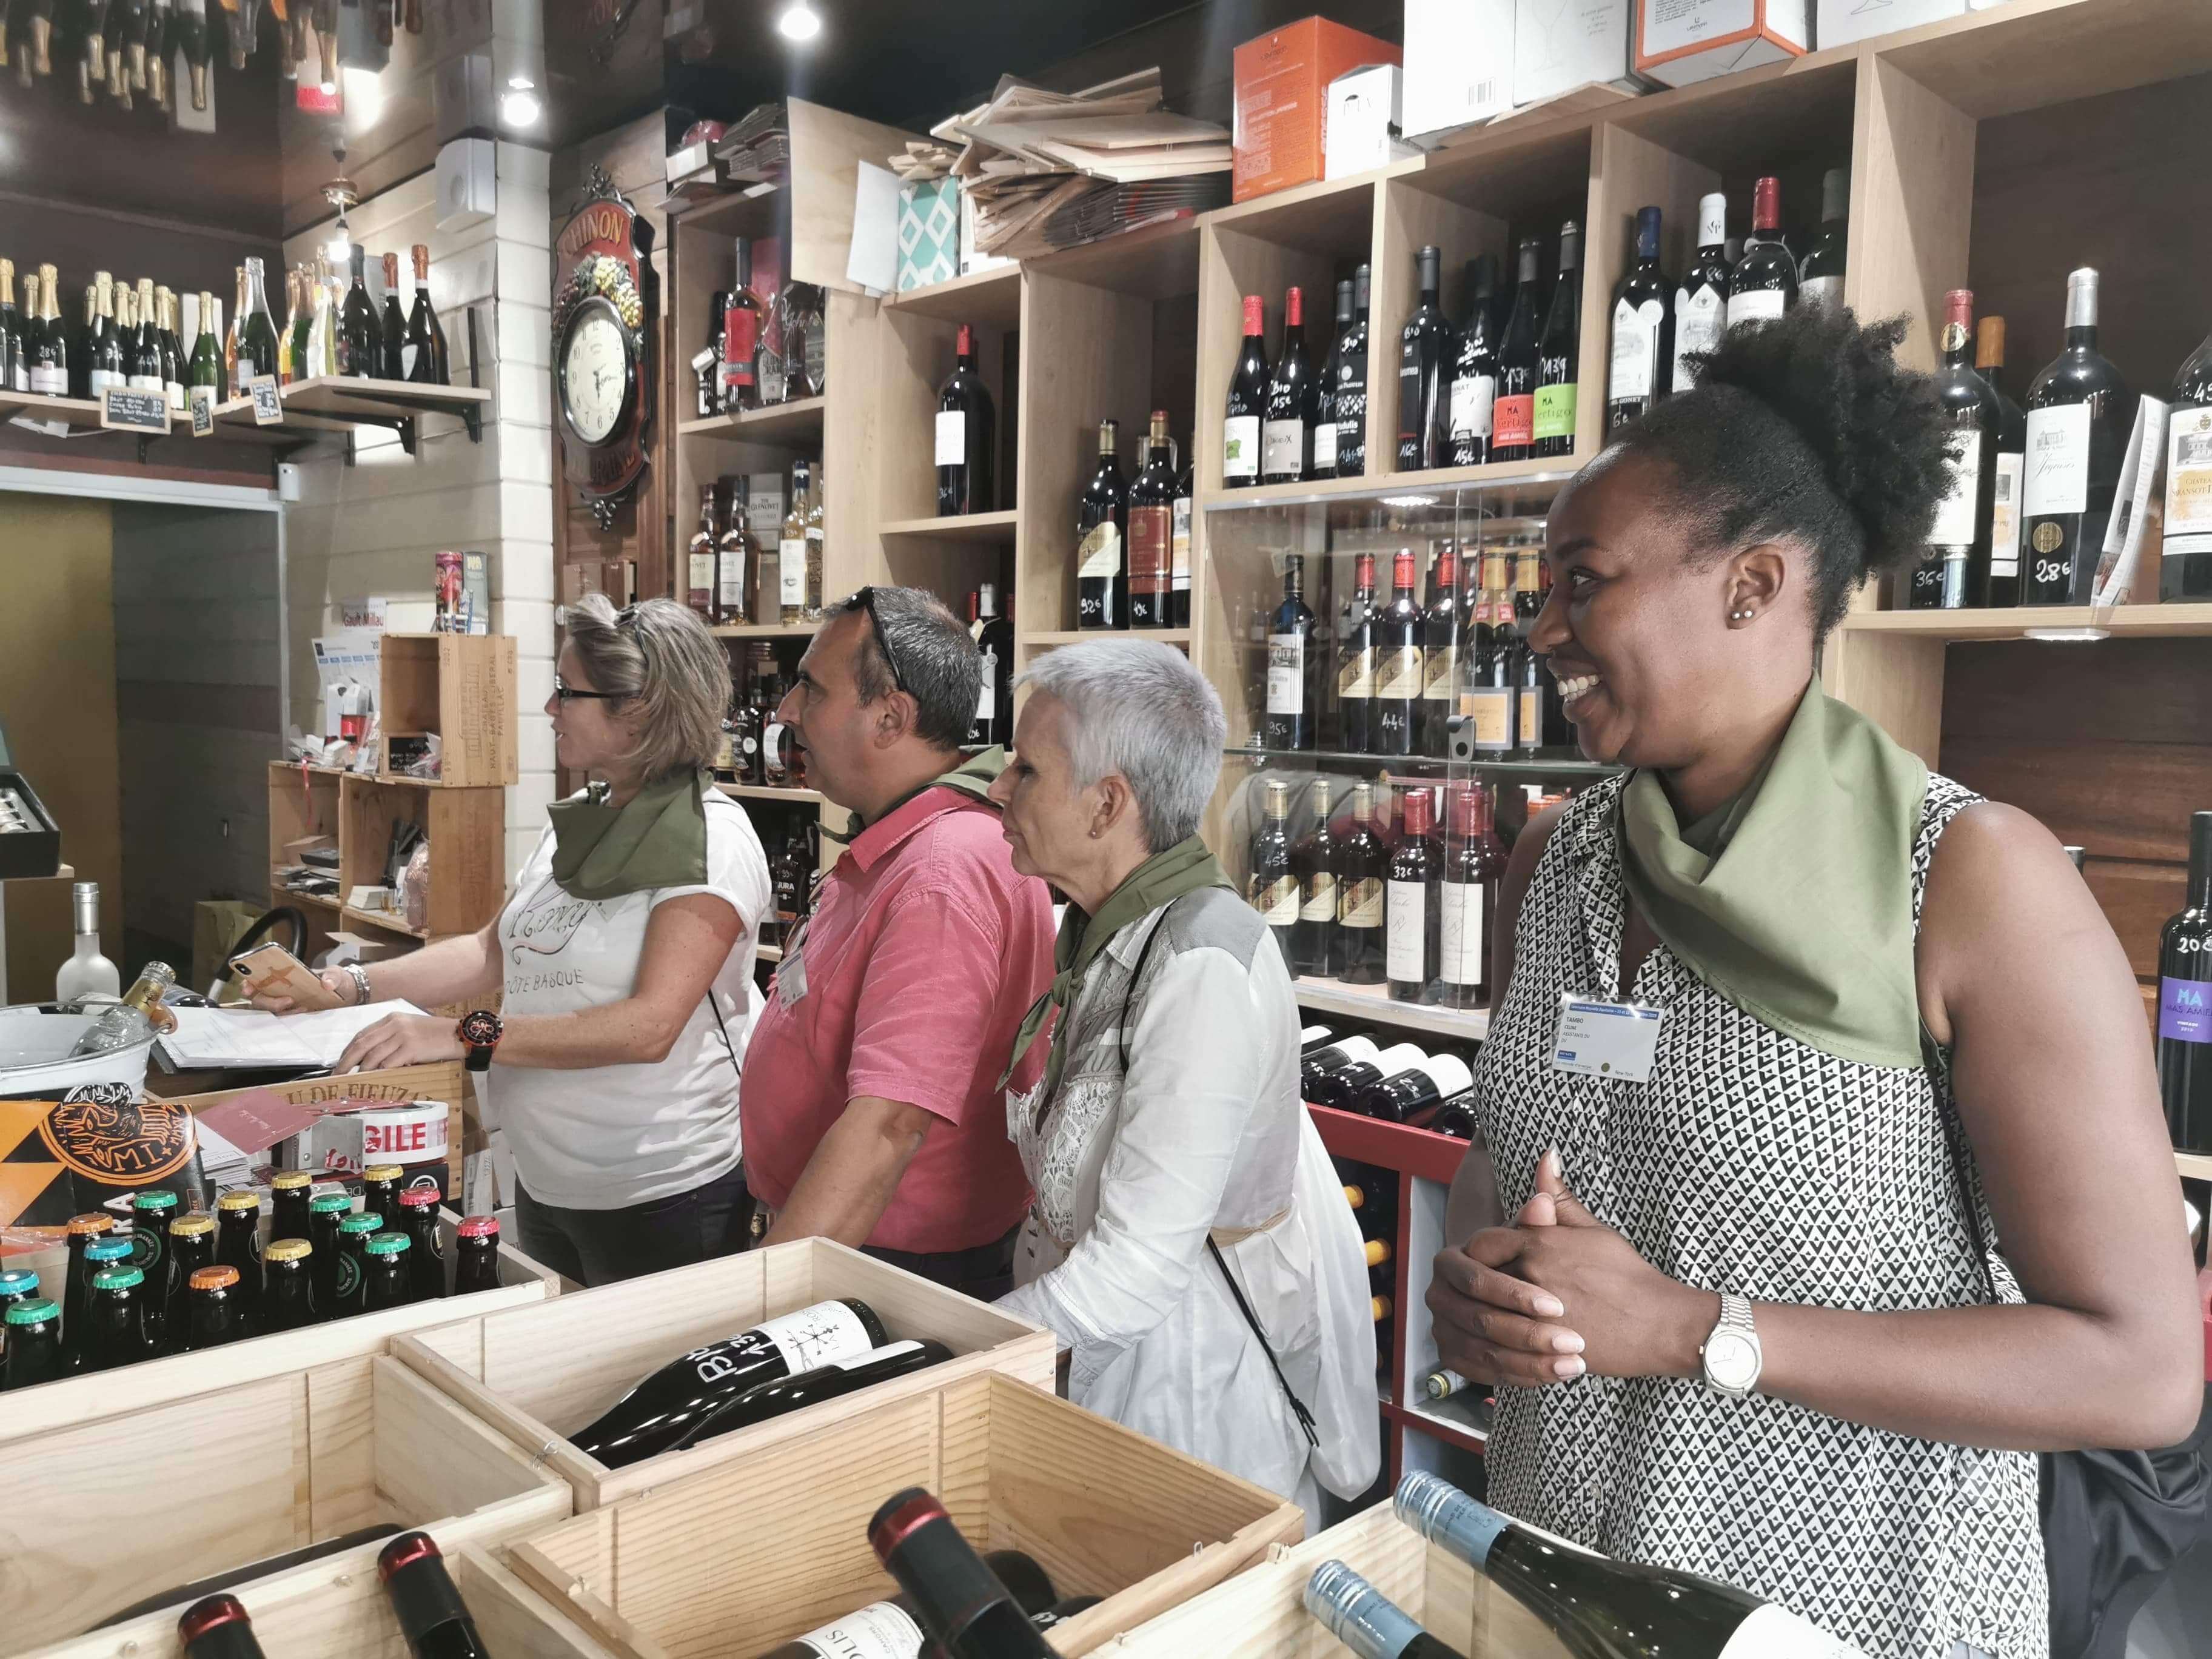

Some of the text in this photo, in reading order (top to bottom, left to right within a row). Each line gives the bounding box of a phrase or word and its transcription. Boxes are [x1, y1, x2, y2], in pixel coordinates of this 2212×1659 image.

[563, 211, 623, 260] CHINON
[1272, 381, 1291, 397] BIO
[597, 415, 603, 429] 6
[2185, 475, 2212, 486] CHATEA
[2035, 558, 2071, 583] 28€
[1381, 712, 1406, 731] 44€
[1265, 856, 1290, 868] 45€
[1393, 865, 1413, 879] 32€
[533, 969, 584, 991] BASQUE
[2177, 988, 2203, 1007] MA
[347, 1082, 434, 1102] FIEUZA
